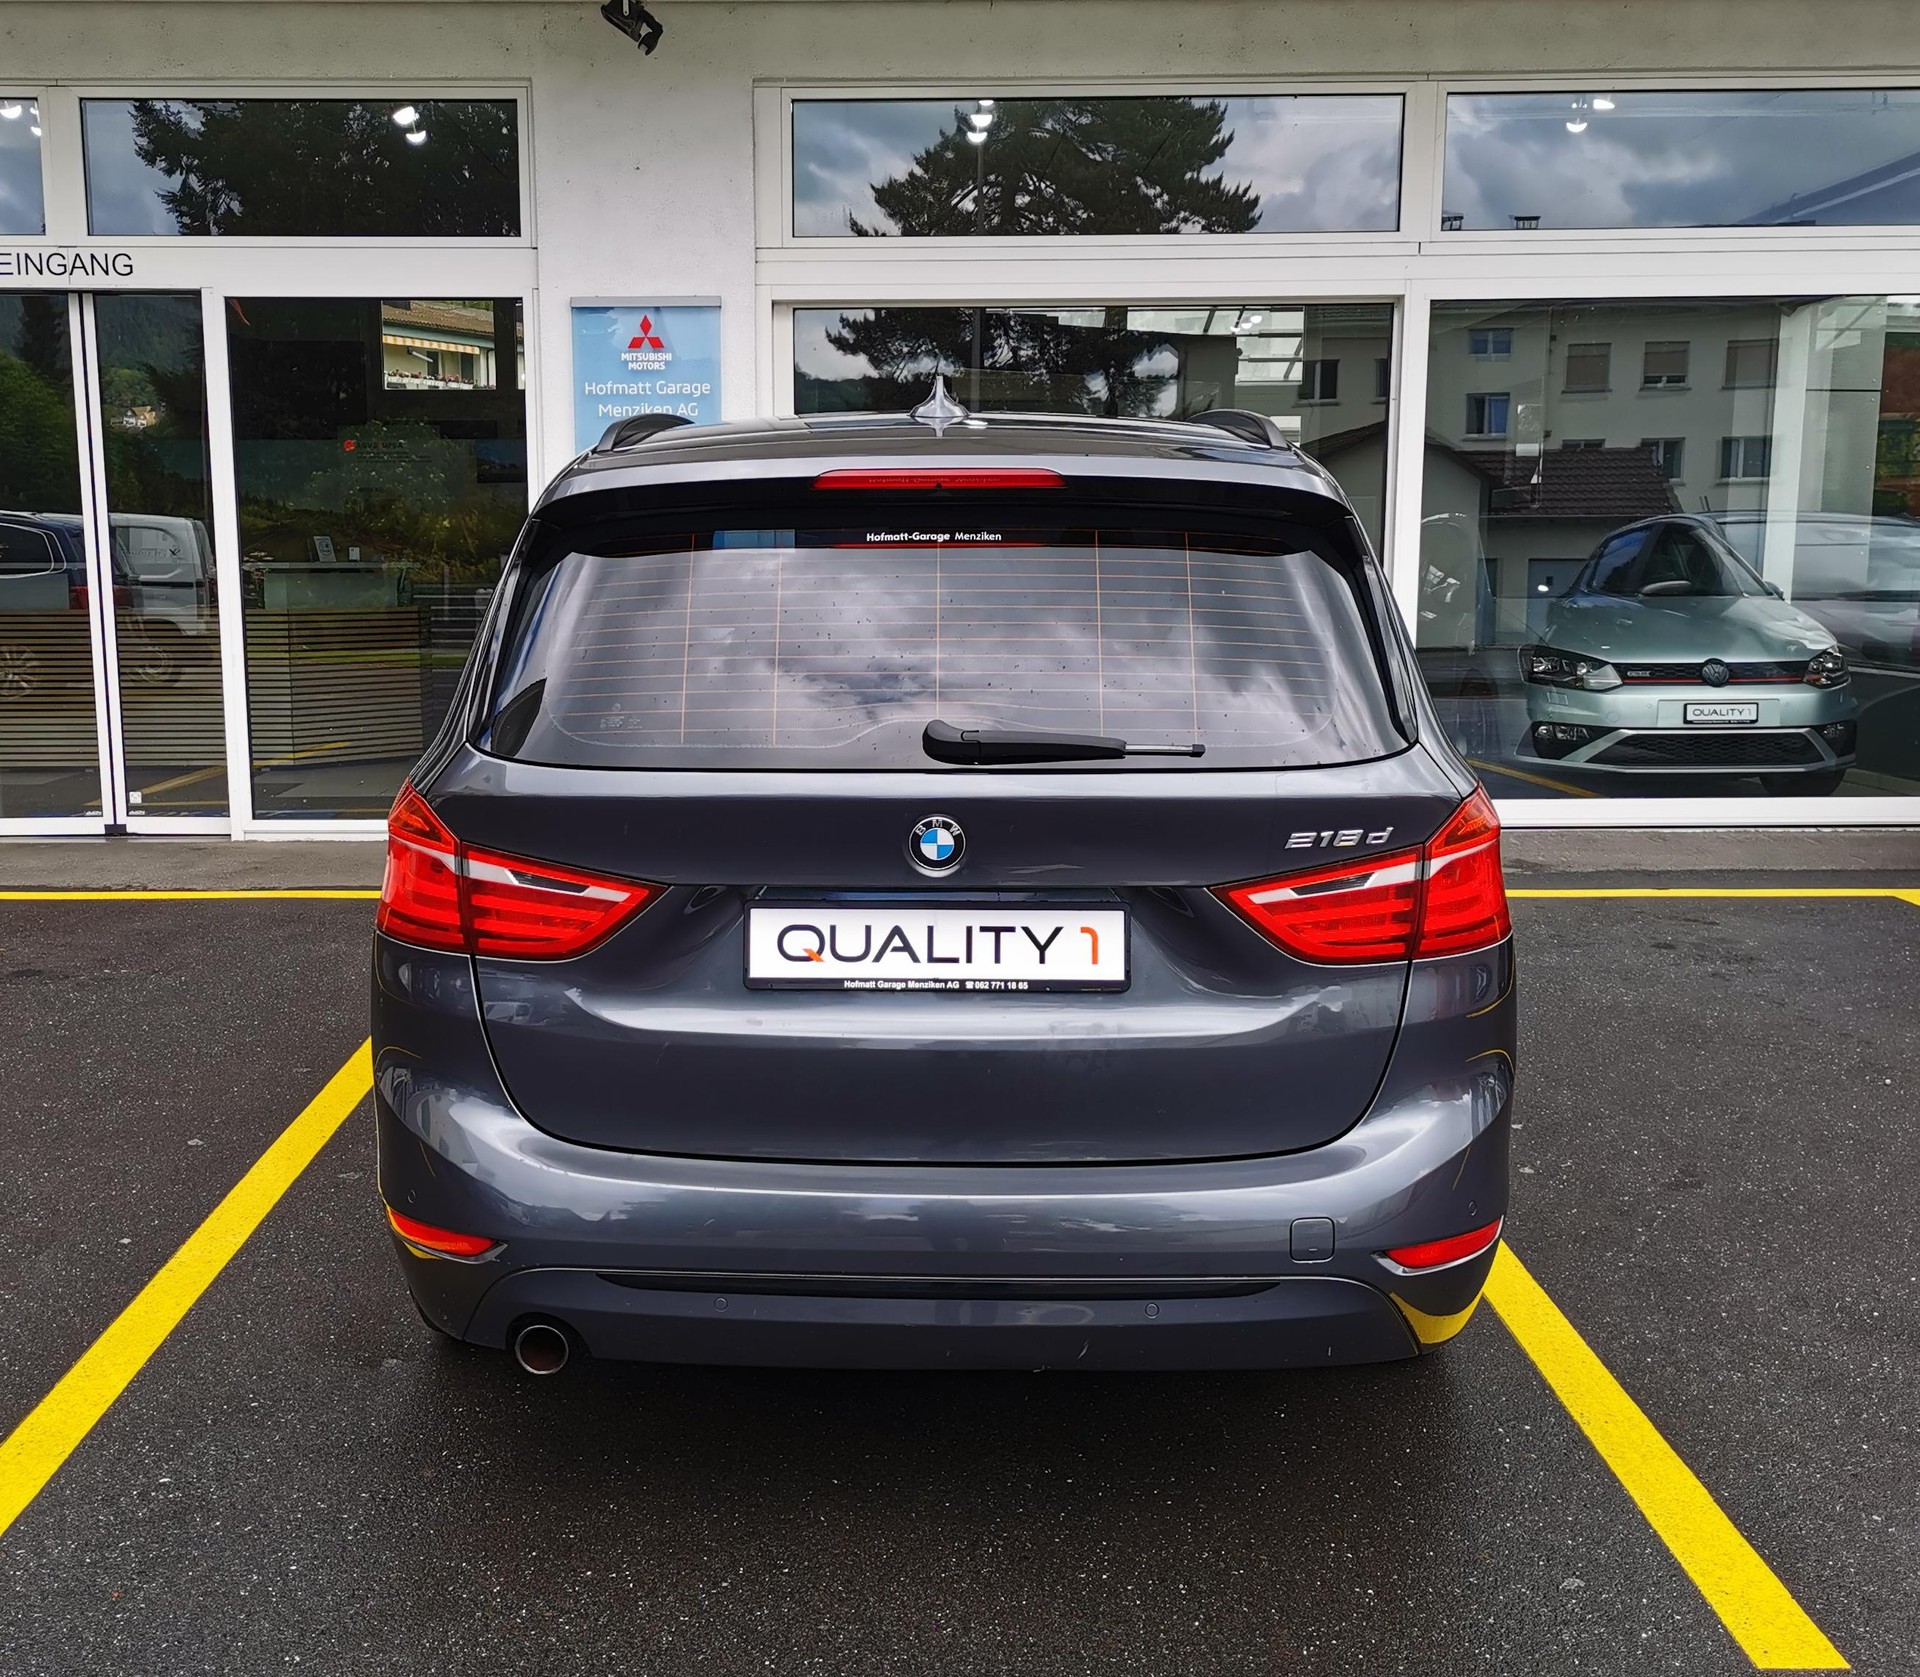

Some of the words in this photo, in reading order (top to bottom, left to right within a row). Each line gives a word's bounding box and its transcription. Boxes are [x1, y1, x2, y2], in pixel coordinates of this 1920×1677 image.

[0, 252, 134, 277] EINGANG
[620, 352, 673, 361] MITSUBISHI
[627, 361, 666, 371] MOTORS
[584, 380, 652, 396] Hofmatt
[655, 380, 712, 398] Garage
[597, 402, 673, 418] Menziken
[676, 402, 699, 417] AG
[865, 531, 951, 543] Hofmatt-Garage
[954, 531, 1002, 542] Menziken
[914, 819, 961, 837] BMW
[776, 924, 1064, 964] QUALITY
[1080, 926, 1099, 965] 1
[843, 979, 876, 989] Hofmatt
[877, 980, 906, 991] Garage
[907, 980, 945, 990] Menziken
[946, 980, 960, 990] AG
[974, 981, 989, 990] 062
[990, 981, 1005, 991] 771
[1006, 981, 1017, 991] 18
